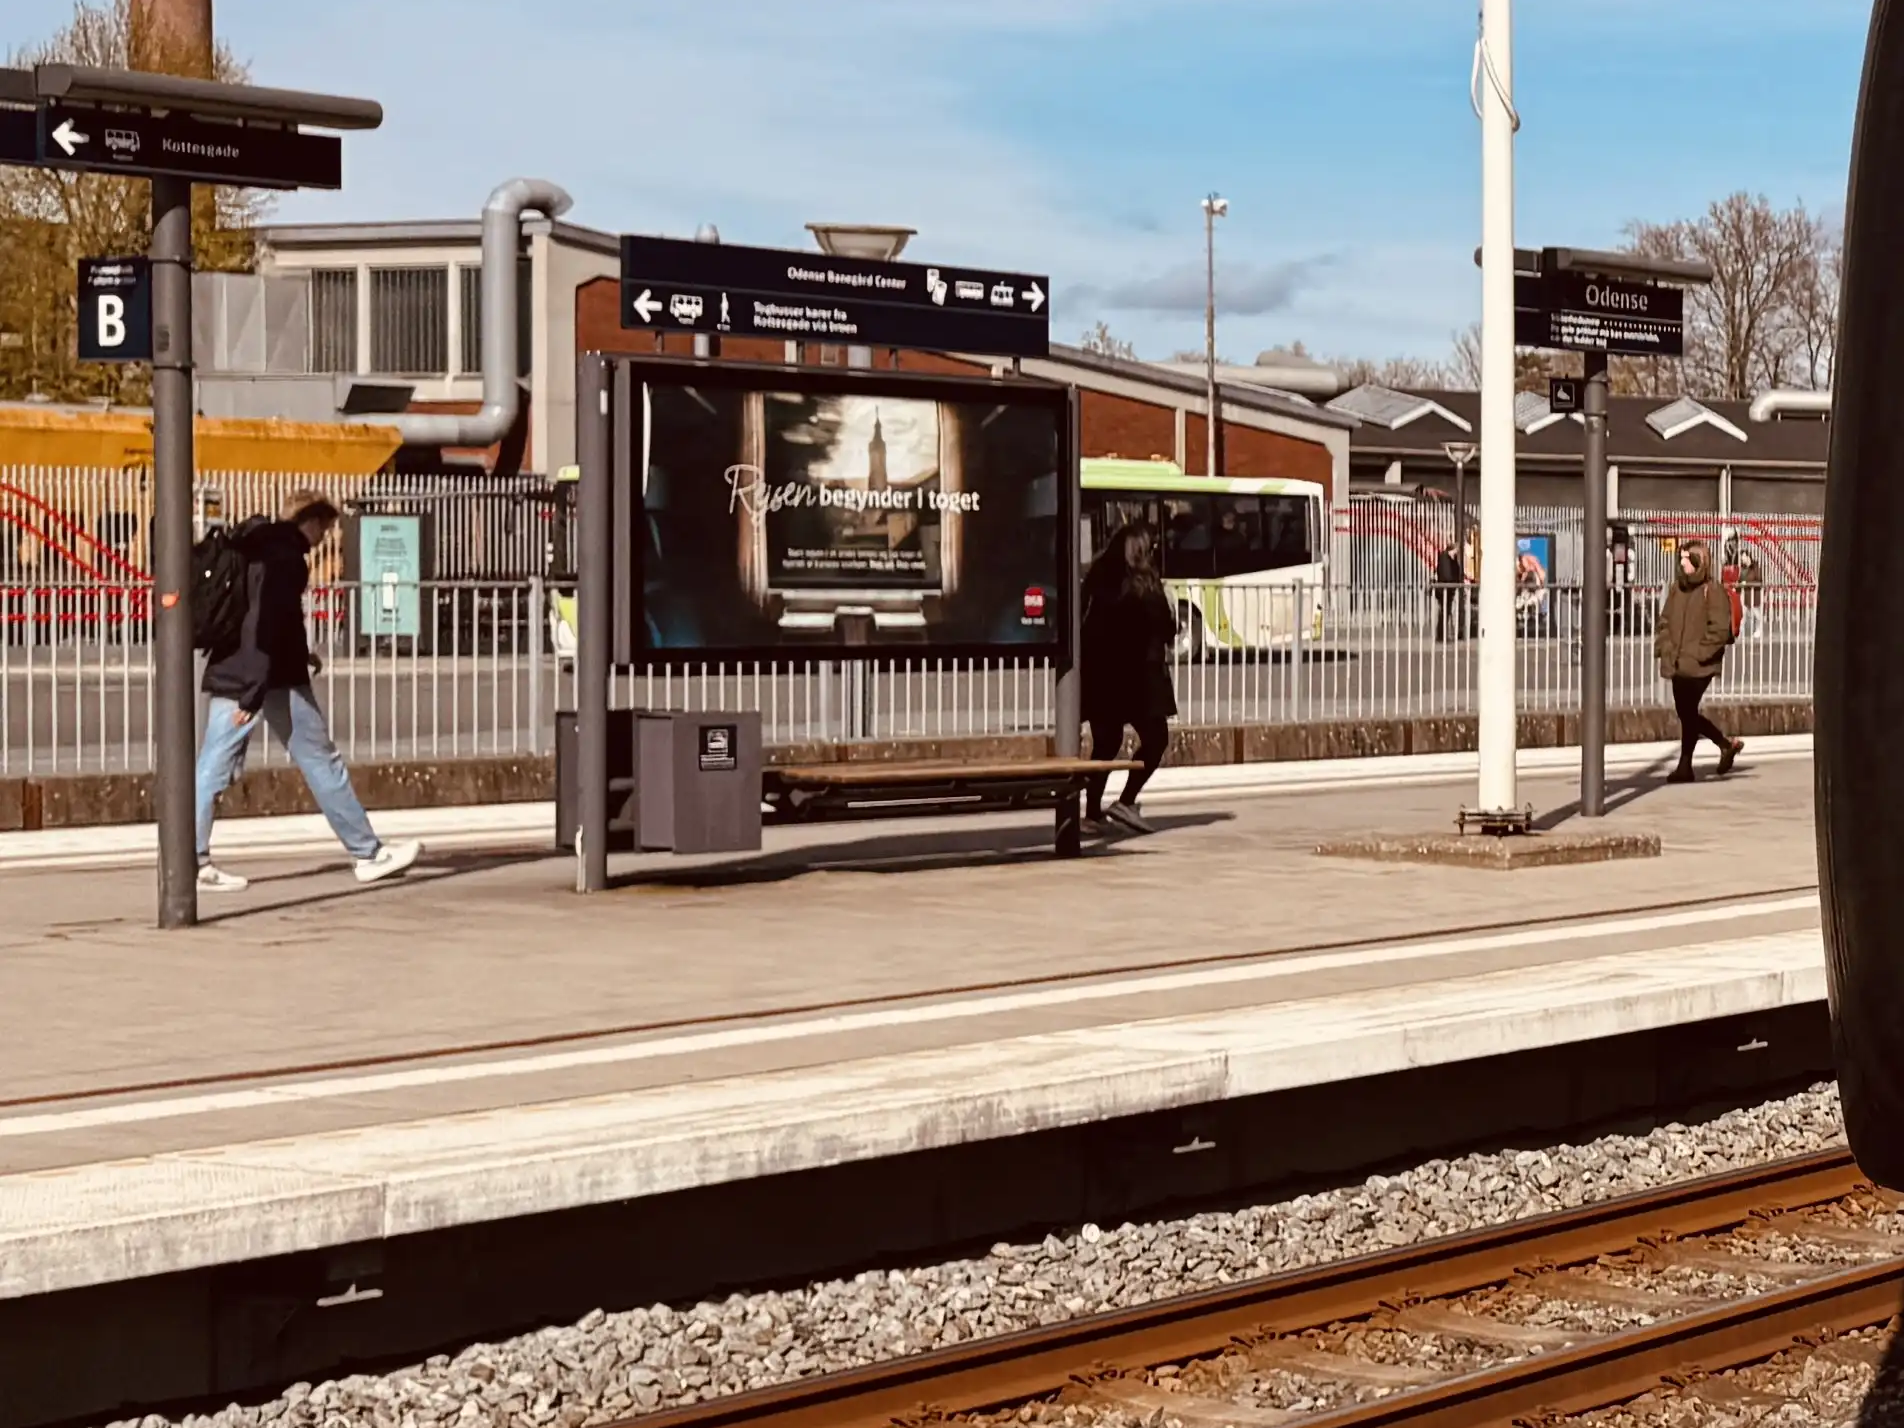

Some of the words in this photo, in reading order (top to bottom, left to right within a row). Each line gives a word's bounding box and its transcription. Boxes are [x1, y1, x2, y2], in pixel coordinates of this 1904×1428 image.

[1585, 284, 1649, 311] Odense
[98, 294, 126, 347] B
[819, 482, 912, 513] begynder
[928, 490, 980, 514] toget
